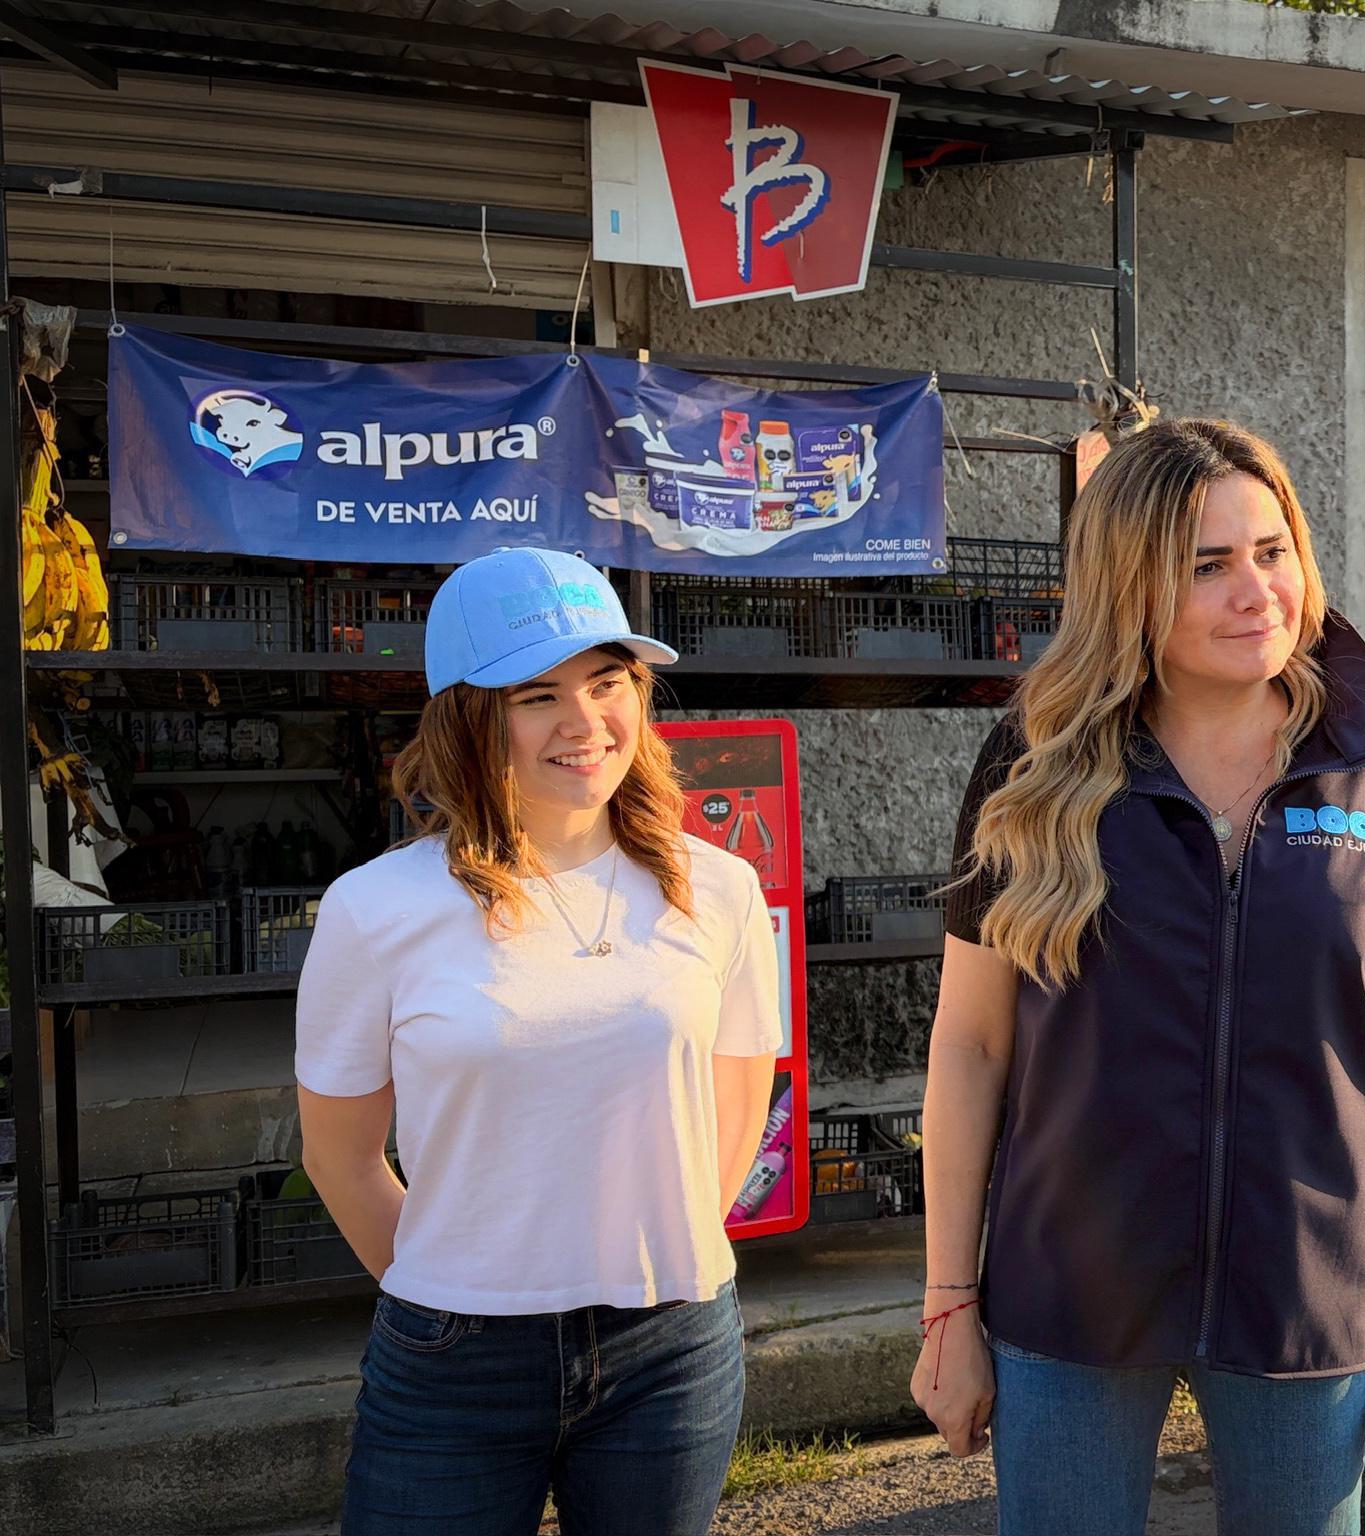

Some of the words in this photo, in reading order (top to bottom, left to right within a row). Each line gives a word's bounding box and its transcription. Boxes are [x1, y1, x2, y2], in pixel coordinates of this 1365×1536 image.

[720, 98, 830, 283] B
[811, 442, 845, 454] alpura
[786, 479, 820, 489] alpura
[316, 500, 356, 523] DE
[364, 500, 462, 524] VENTA
[470, 494, 539, 522] AQUÍ
[692, 507, 737, 519] CREMA
[865, 539, 901, 551] COME
[904, 539, 931, 550] BIEN
[813, 552, 844, 564] Imagen
[883, 551, 895, 561] del
[896, 550, 929, 562] producto
[1286, 835, 1343, 847] CIUDAD
